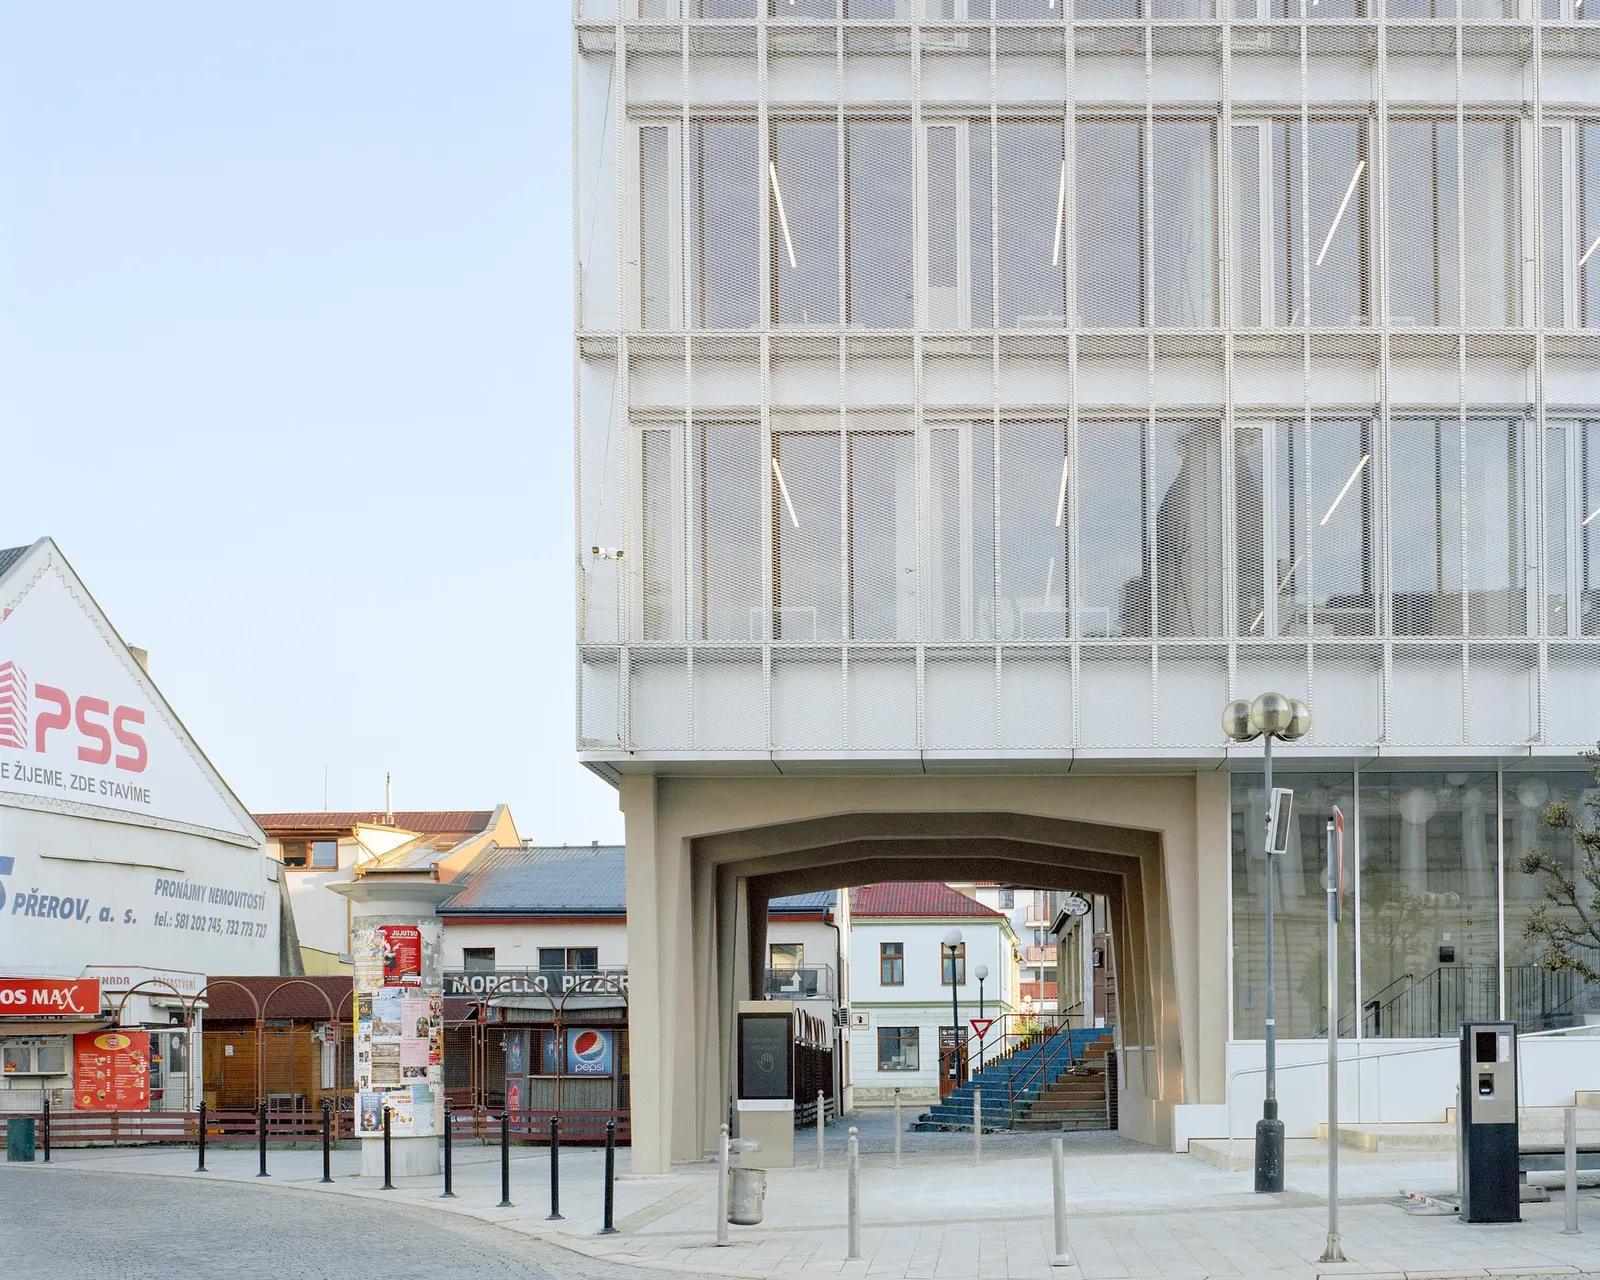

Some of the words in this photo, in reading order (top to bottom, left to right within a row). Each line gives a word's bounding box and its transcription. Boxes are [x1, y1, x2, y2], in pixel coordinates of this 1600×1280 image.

[34, 682, 148, 774] PSS
[14, 760, 67, 791] ŽIJEME,
[70, 773, 96, 793] ZDE
[100, 779, 151, 804] STAVÍME
[11, 887, 92, 924] PŘEROV,
[98, 906, 115, 923] a.
[123, 908, 137, 924] s.
[154, 878, 207, 902] PRONÁJMY
[208, 886, 266, 911] NEMOVITOSTÍ
[154, 910, 173, 928] tel.:
[174, 912, 190, 930] 581
[190, 914, 207, 932] 202
[225, 919, 240, 936] 732
[240, 921, 254, 937] 773
[91, 976, 130, 986] NADA
[451, 975, 549, 993] MORELLO
[0, 989, 28, 1005] OS
[31, 985, 85, 1013] MAX
[1364, 1000, 1380, 1036] 1
[574, 1062, 604, 1073] pepsi
